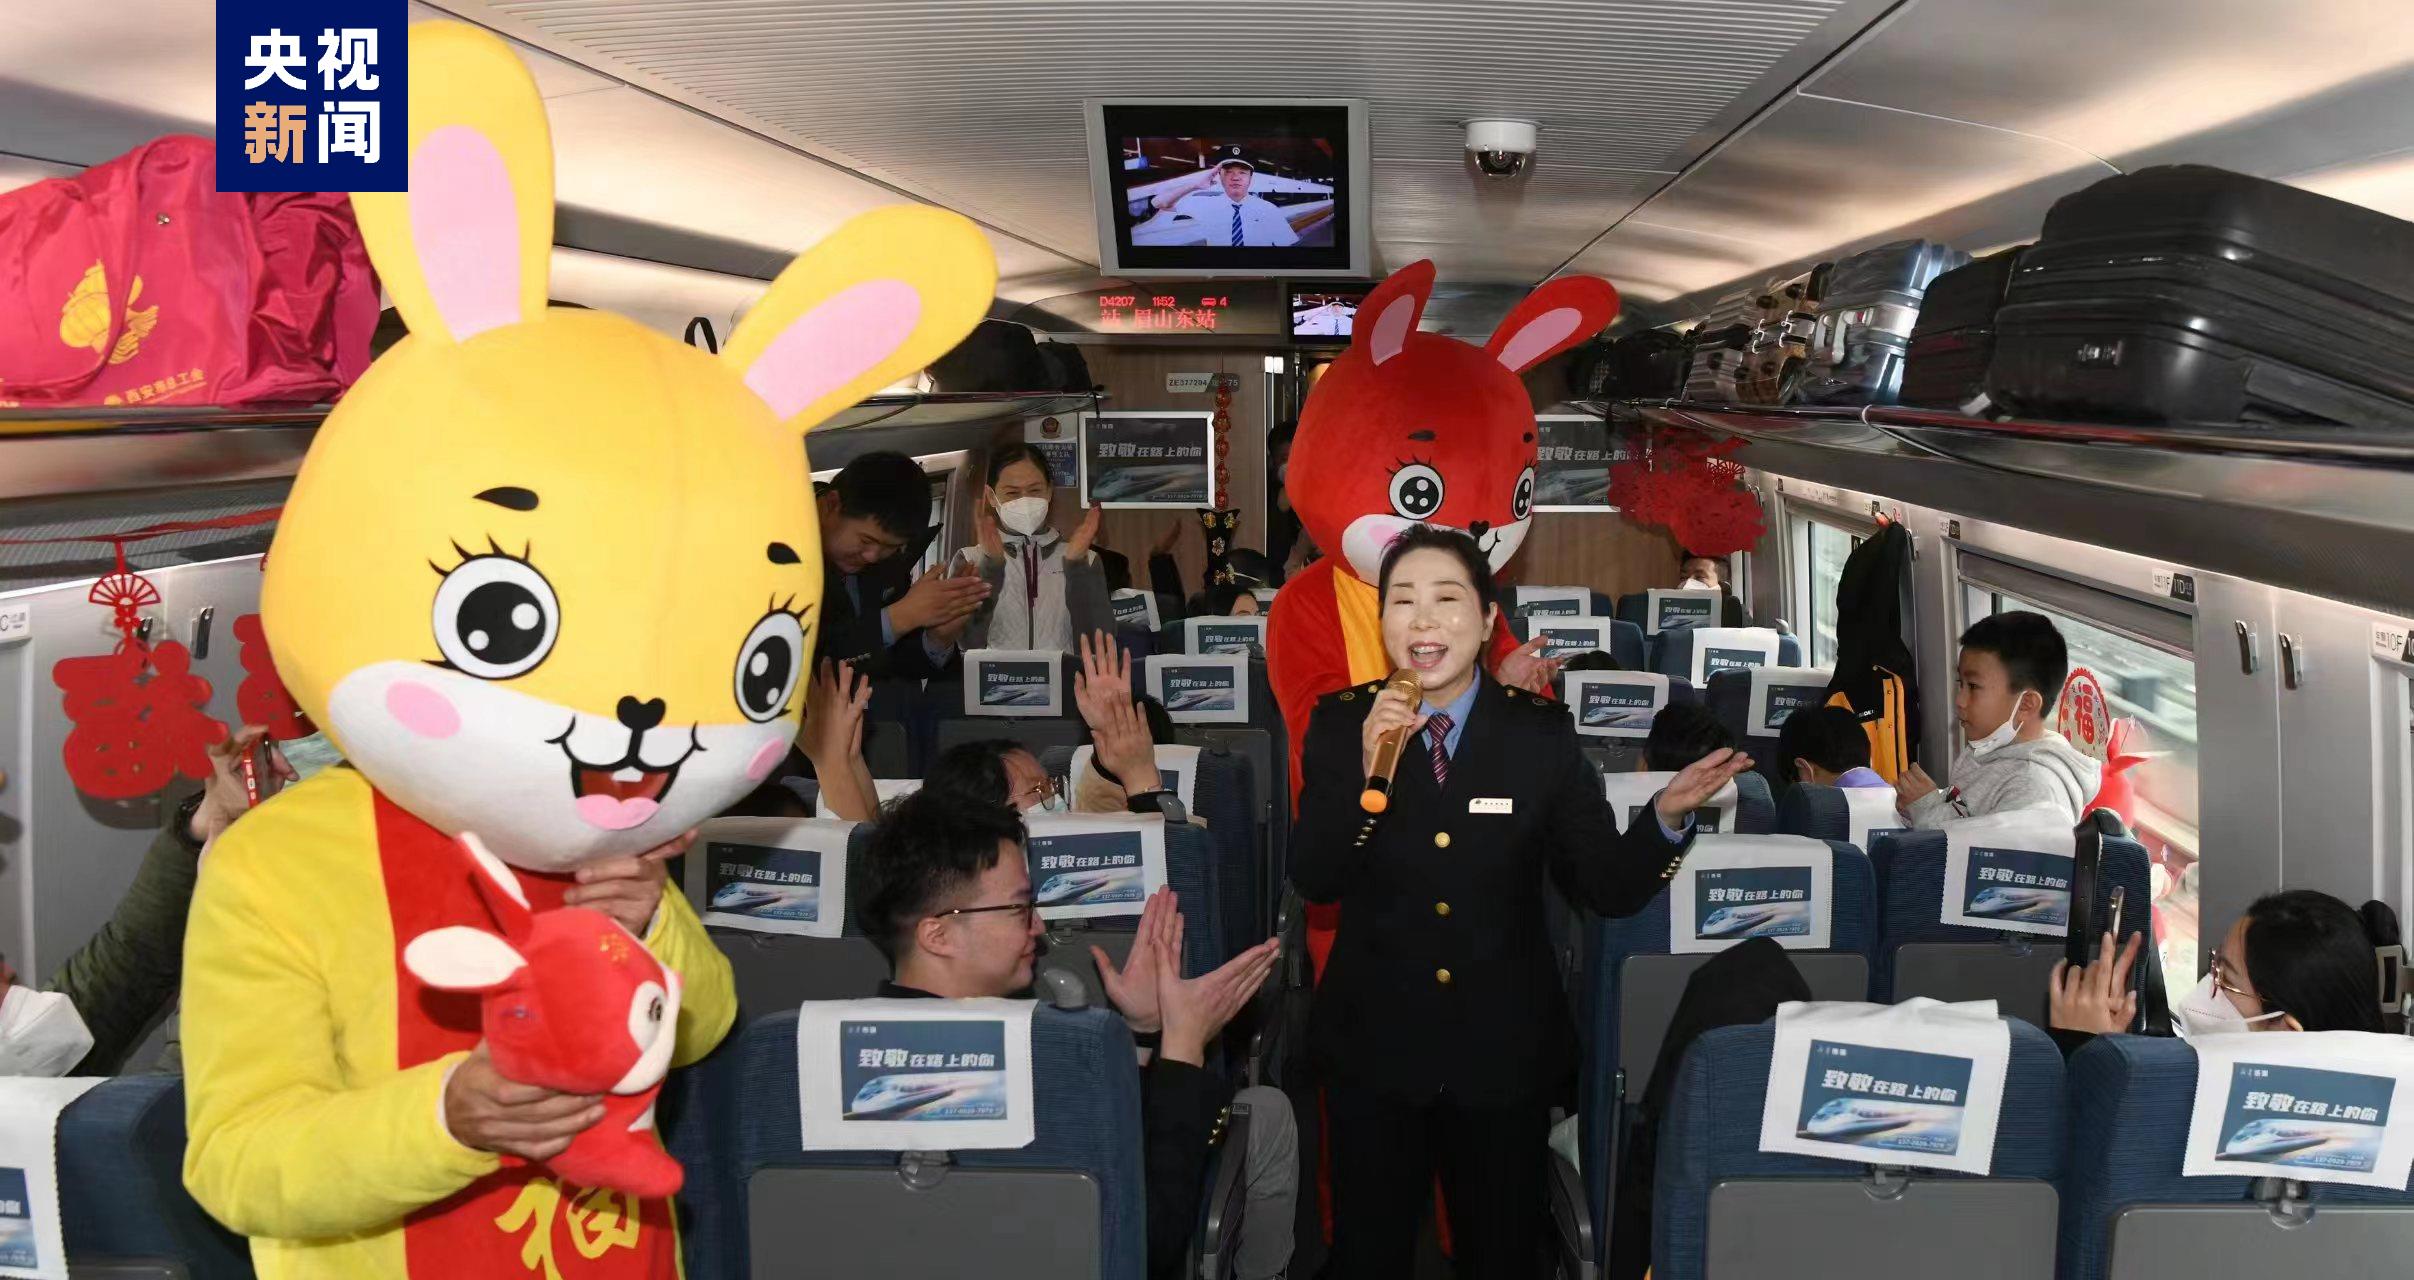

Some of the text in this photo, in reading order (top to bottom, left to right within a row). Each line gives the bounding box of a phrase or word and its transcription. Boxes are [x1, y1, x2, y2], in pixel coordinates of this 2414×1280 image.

[1099, 296, 1135, 306] D4207
[1219, 296, 1228, 306] 4
[1101, 308, 1217, 329] 站 眉山东站
[1098, 442, 1203, 458] 致敬在路上的你
[2074, 683, 2095, 745] 福
[1040, 854, 1136, 869] 致敬在路上的你
[719, 862, 813, 884] 致敬在路上的你
[1978, 867, 2069, 889] 致敬在路上的你
[1707, 888, 1804, 902] 致敬在路上的你
[857, 1048, 996, 1068] 致敬在路上的你
[1821, 1069, 1958, 1103] 致敬在路上的你
[2243, 1091, 2378, 1122] 致敬在路上的你
